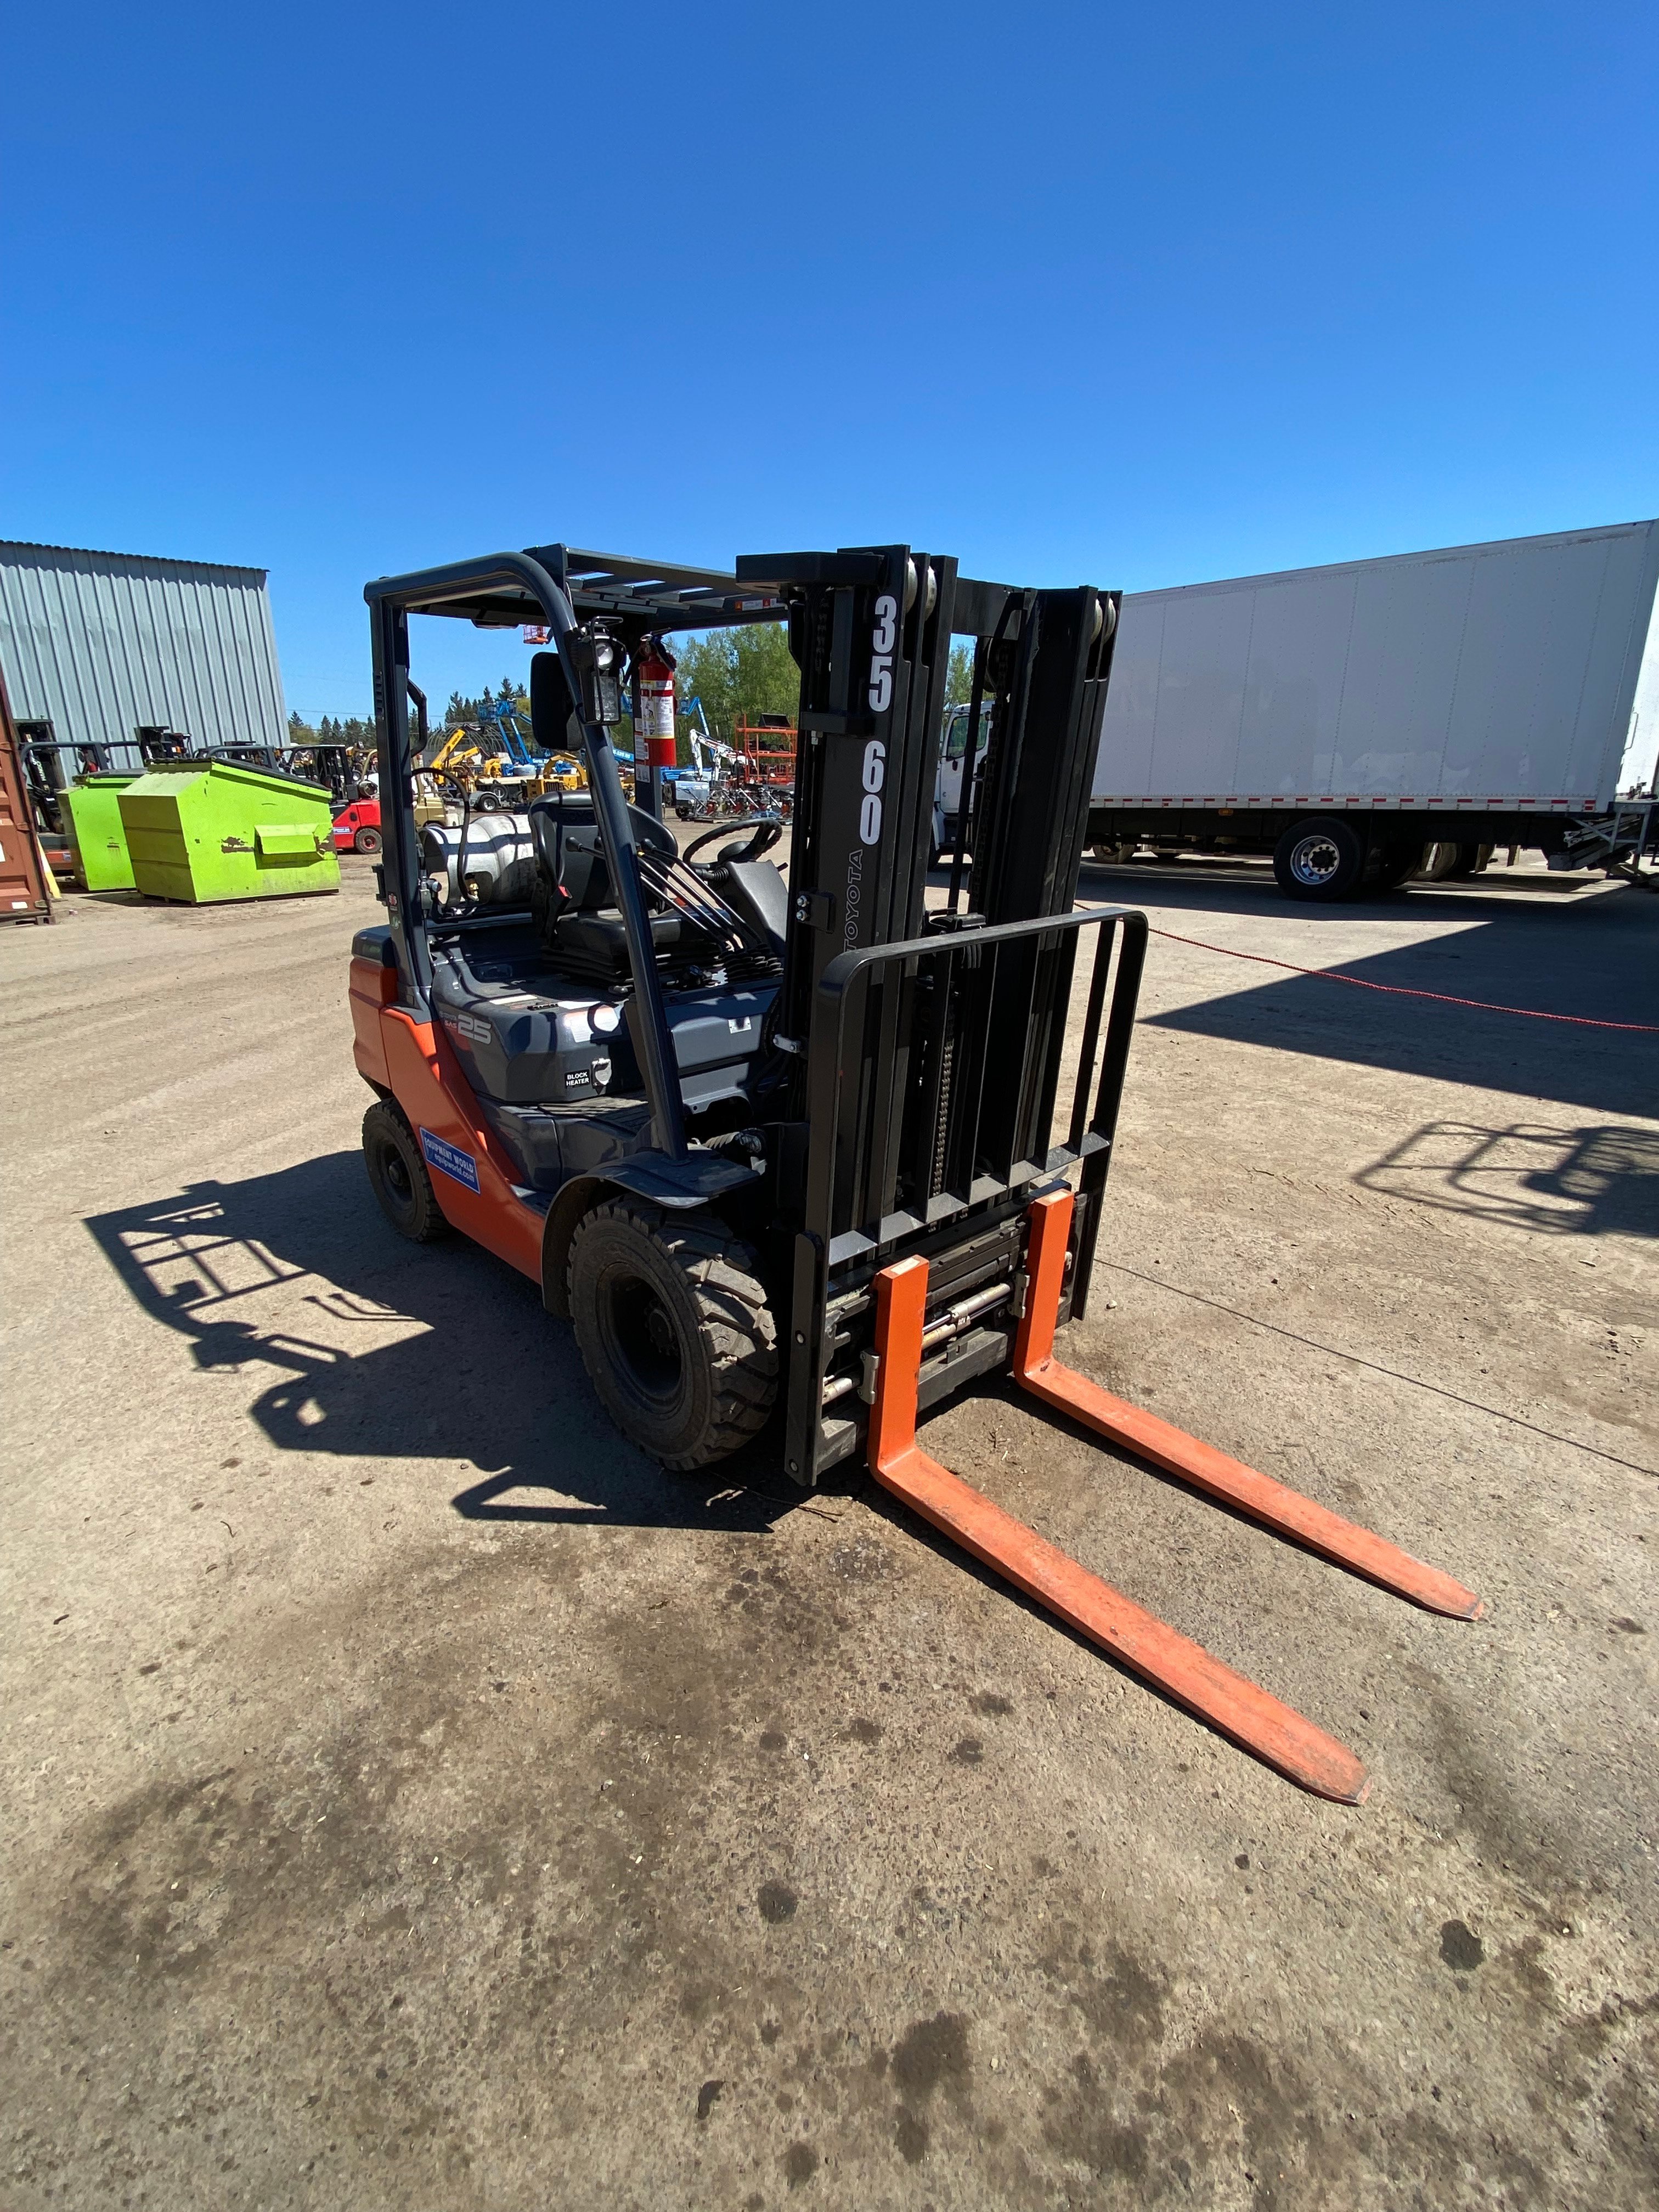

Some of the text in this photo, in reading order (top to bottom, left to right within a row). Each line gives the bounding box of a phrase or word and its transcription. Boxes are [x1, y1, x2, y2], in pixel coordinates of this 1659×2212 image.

[843, 849, 863, 952] TOYOTA
[458, 1014, 492, 1045] 25
[566, 1077, 589, 1086] HEATER
[567, 1071, 588, 1080] BLOCK
[424, 1137, 475, 1173] EQUIPMENT WORLD
[434, 1153, 475, 1183] equipworld.com
